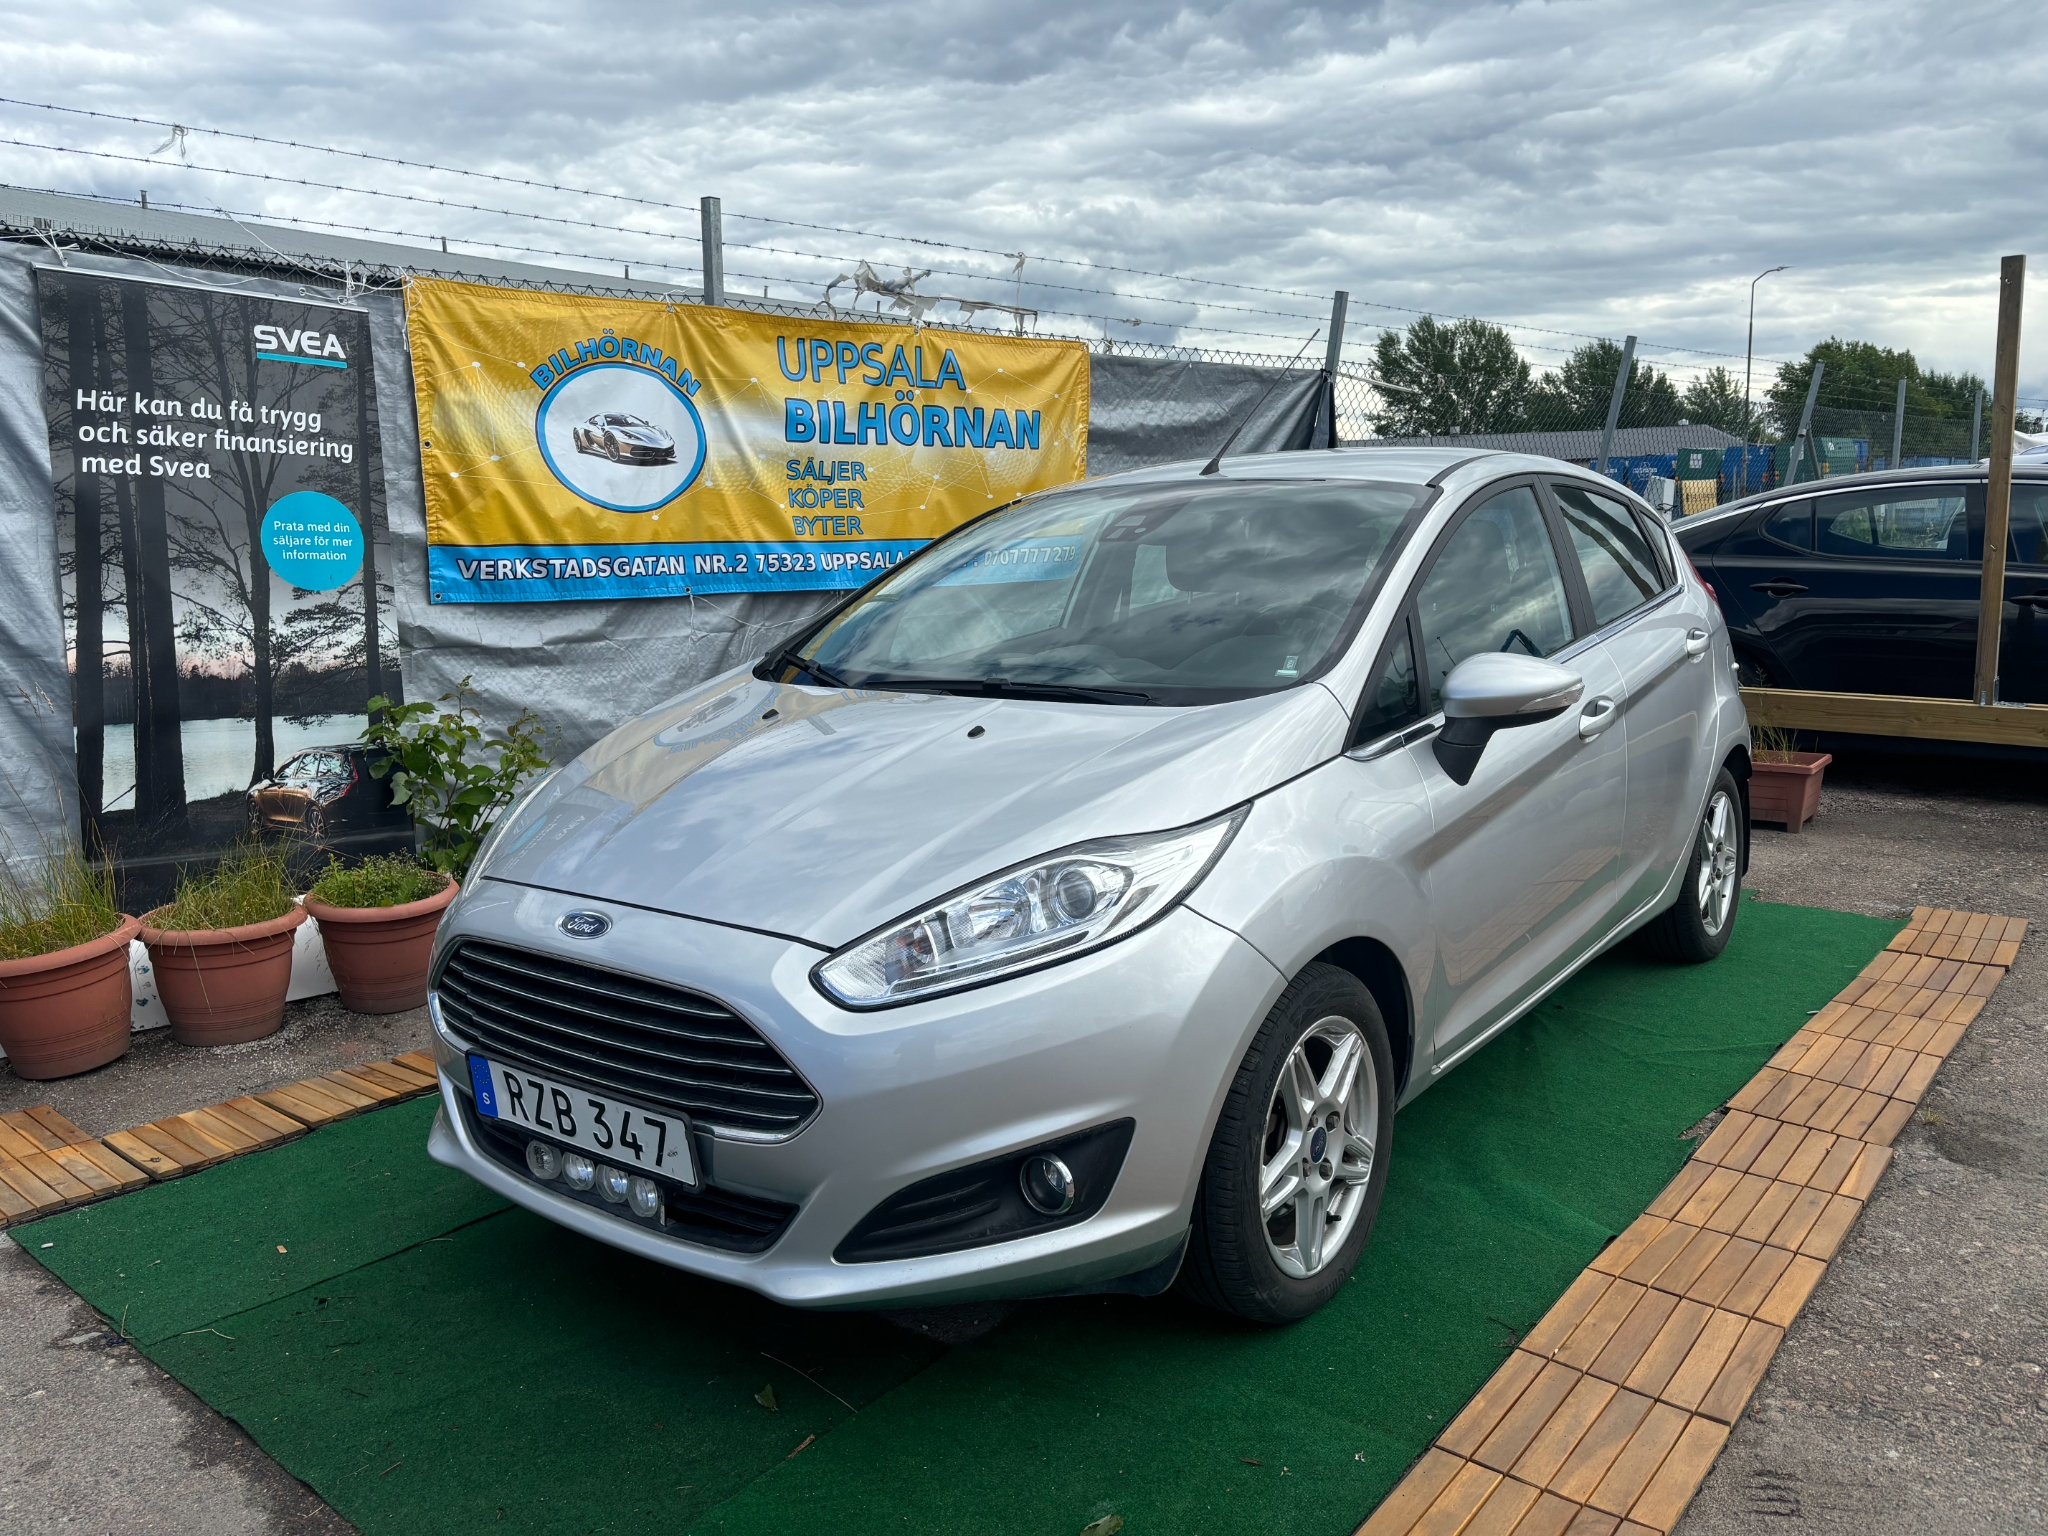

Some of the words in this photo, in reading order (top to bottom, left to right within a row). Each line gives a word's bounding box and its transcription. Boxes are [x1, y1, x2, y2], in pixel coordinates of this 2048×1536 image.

[253, 324, 347, 360] SVEA
[529, 328, 702, 398] BILHÖRNAN
[776, 335, 966, 390] UPPSALA
[76, 388, 127, 413] Här
[134, 391, 183, 417] kan
[190, 396, 223, 420] du
[229, 397, 254, 423] få
[260, 404, 322, 433] trygg
[784, 390, 1041, 450] BILHÖRNAN
[78, 422, 128, 445] och
[136, 424, 208, 449] säker
[215, 428, 354, 463] finansiering
[81, 453, 142, 476] med
[149, 456, 212, 479] Svea
[786, 457, 867, 485] SÄLJER
[787, 483, 865, 509] KÖPER
[273, 520, 304, 532] Prata
[307, 521, 331, 532] med
[333, 522, 350, 533] din
[792, 515, 865, 536] BYTER
[273, 534, 312, 548] säljare
[314, 535, 330, 546] för
[332, 539, 353, 547] mer
[282, 549, 347, 560] information
[456, 554, 686, 582] VERKSTADSGATAN
[694, 551, 749, 576] NR.2
[754, 551, 817, 574] 75323
[566, 915, 604, 934] Ford
[482, 1091, 491, 1105] S
[502, 1069, 578, 1138] RZB
[588, 1097, 668, 1168] 347
